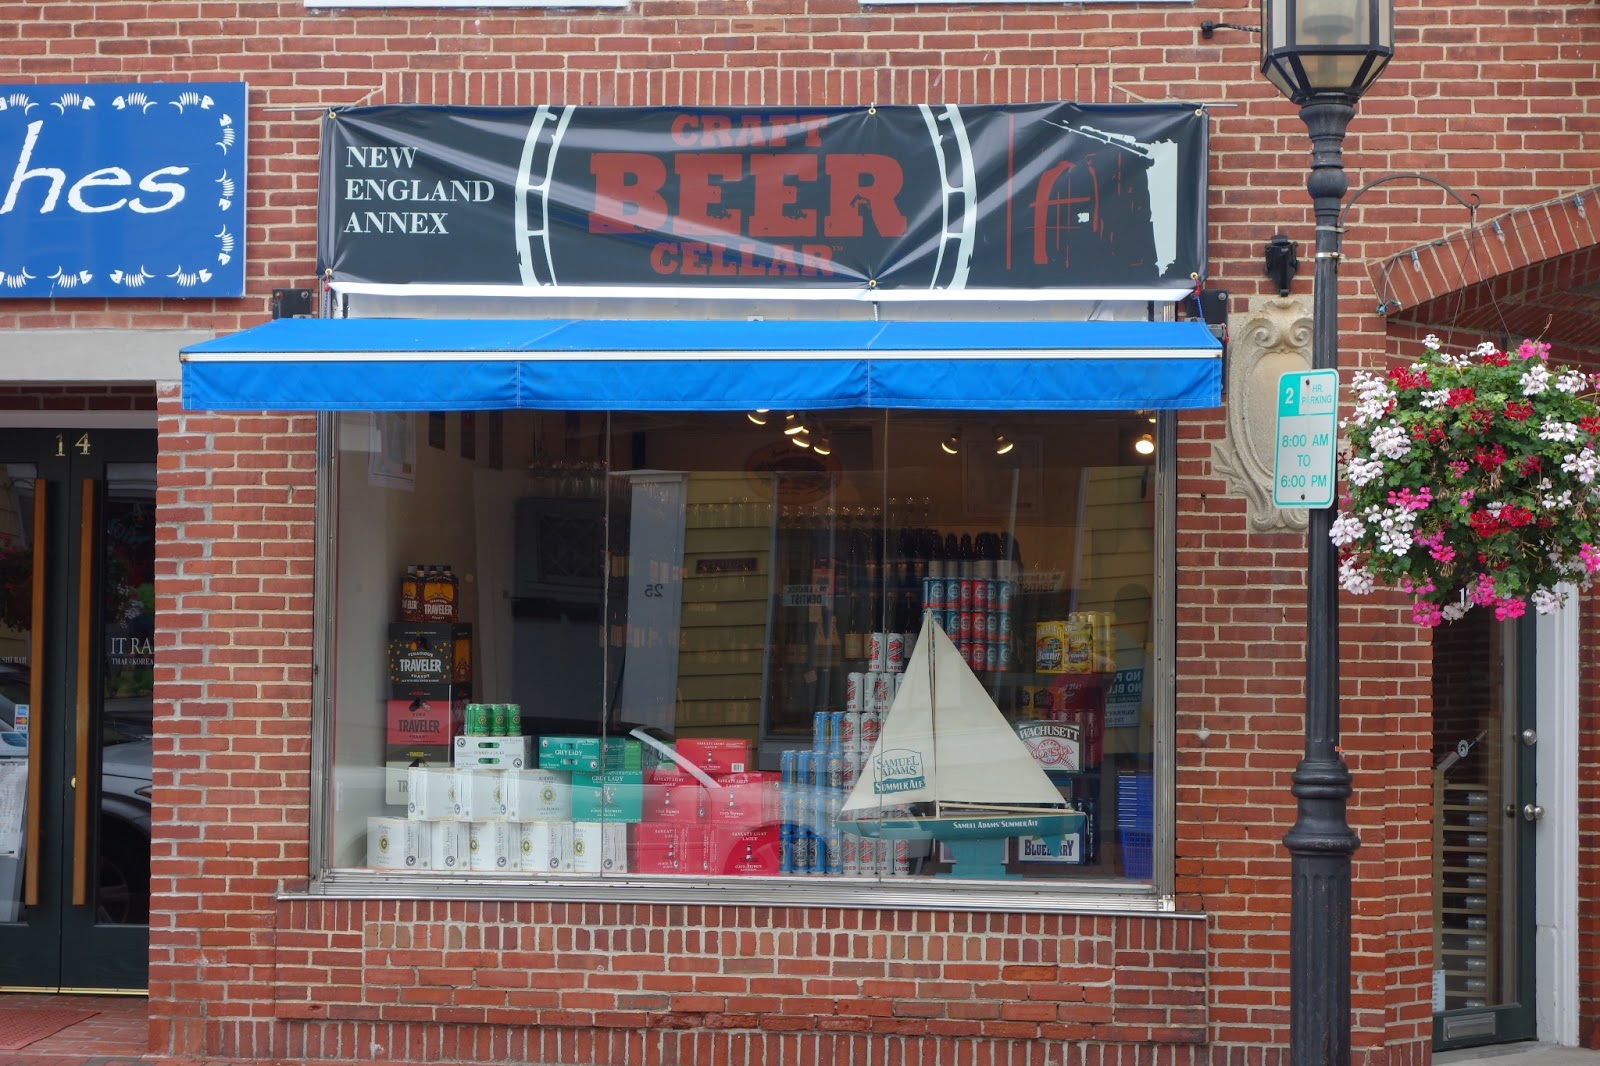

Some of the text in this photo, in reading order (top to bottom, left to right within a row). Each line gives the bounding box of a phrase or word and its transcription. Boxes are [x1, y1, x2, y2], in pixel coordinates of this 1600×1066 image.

[670, 113, 829, 148] CRAFT
[345, 146, 419, 169] NEW
[344, 178, 495, 202] ENGLAND
[588, 152, 908, 238] BEER
[343, 211, 449, 235] ANNEX
[650, 241, 834, 277] CELLAR
[1284, 387, 1295, 405] 2
[1301, 394, 1332, 405] PRKING
[1282, 433, 1329, 448] 8:00 AM
[1297, 454, 1311, 467] TO
[1280, 474, 1327, 488] 6:00 PM
[423, 604, 453, 615] TRAVELER
[110, 637, 154, 655] IT RA
[112, 657, 128, 665] THAI
[399, 658, 442, 673] TRAVELER
[398, 719, 440, 734] TRAVELER
[1019, 725, 1080, 741] WACHUSETT
[876, 755, 920, 770] SAMUEL
[880, 765, 918, 777] ADAMS
[875, 779, 923, 792] SUMMER ALE
[952, 821, 976, 830] SAMUEL
[1000, 819, 1028, 828] SUMMER
[1027, 819, 1039, 827] ALE
[1024, 839, 1074, 857] BLUERRY
